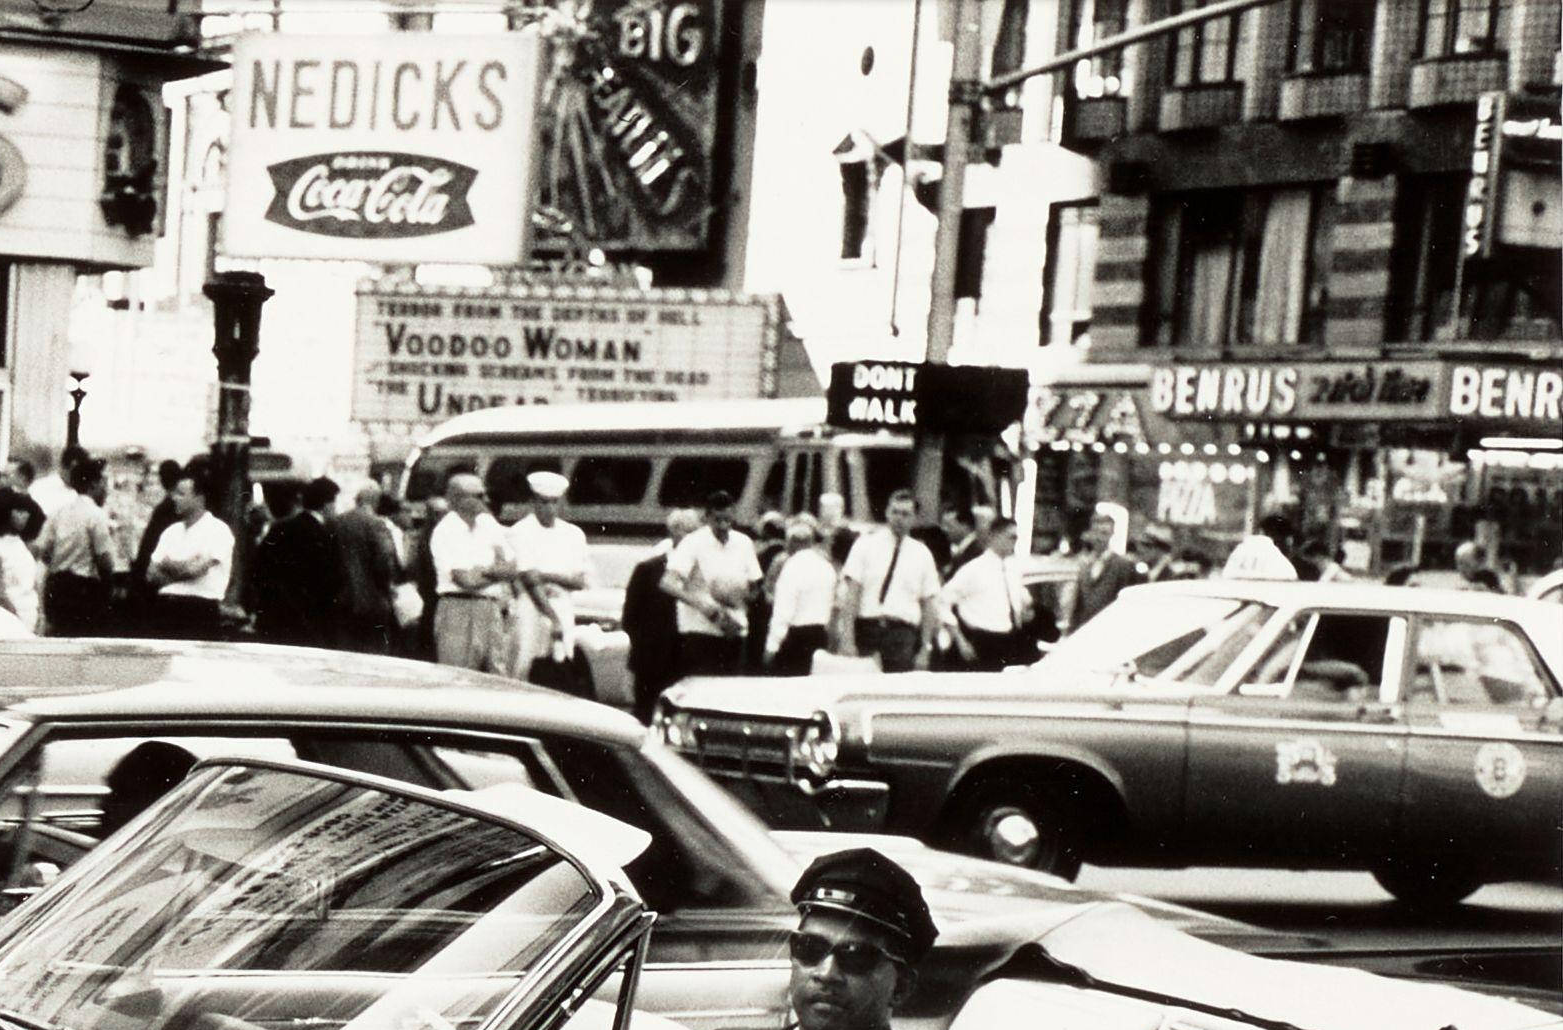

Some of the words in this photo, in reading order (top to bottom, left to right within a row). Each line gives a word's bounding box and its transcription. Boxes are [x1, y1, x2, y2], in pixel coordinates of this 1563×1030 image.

[617, 4, 704, 67] BIG
[248, 59, 508, 131] NEDICKS
[848, 396, 917, 424] WALK
[1150, 366, 1297, 415] BENRUS
